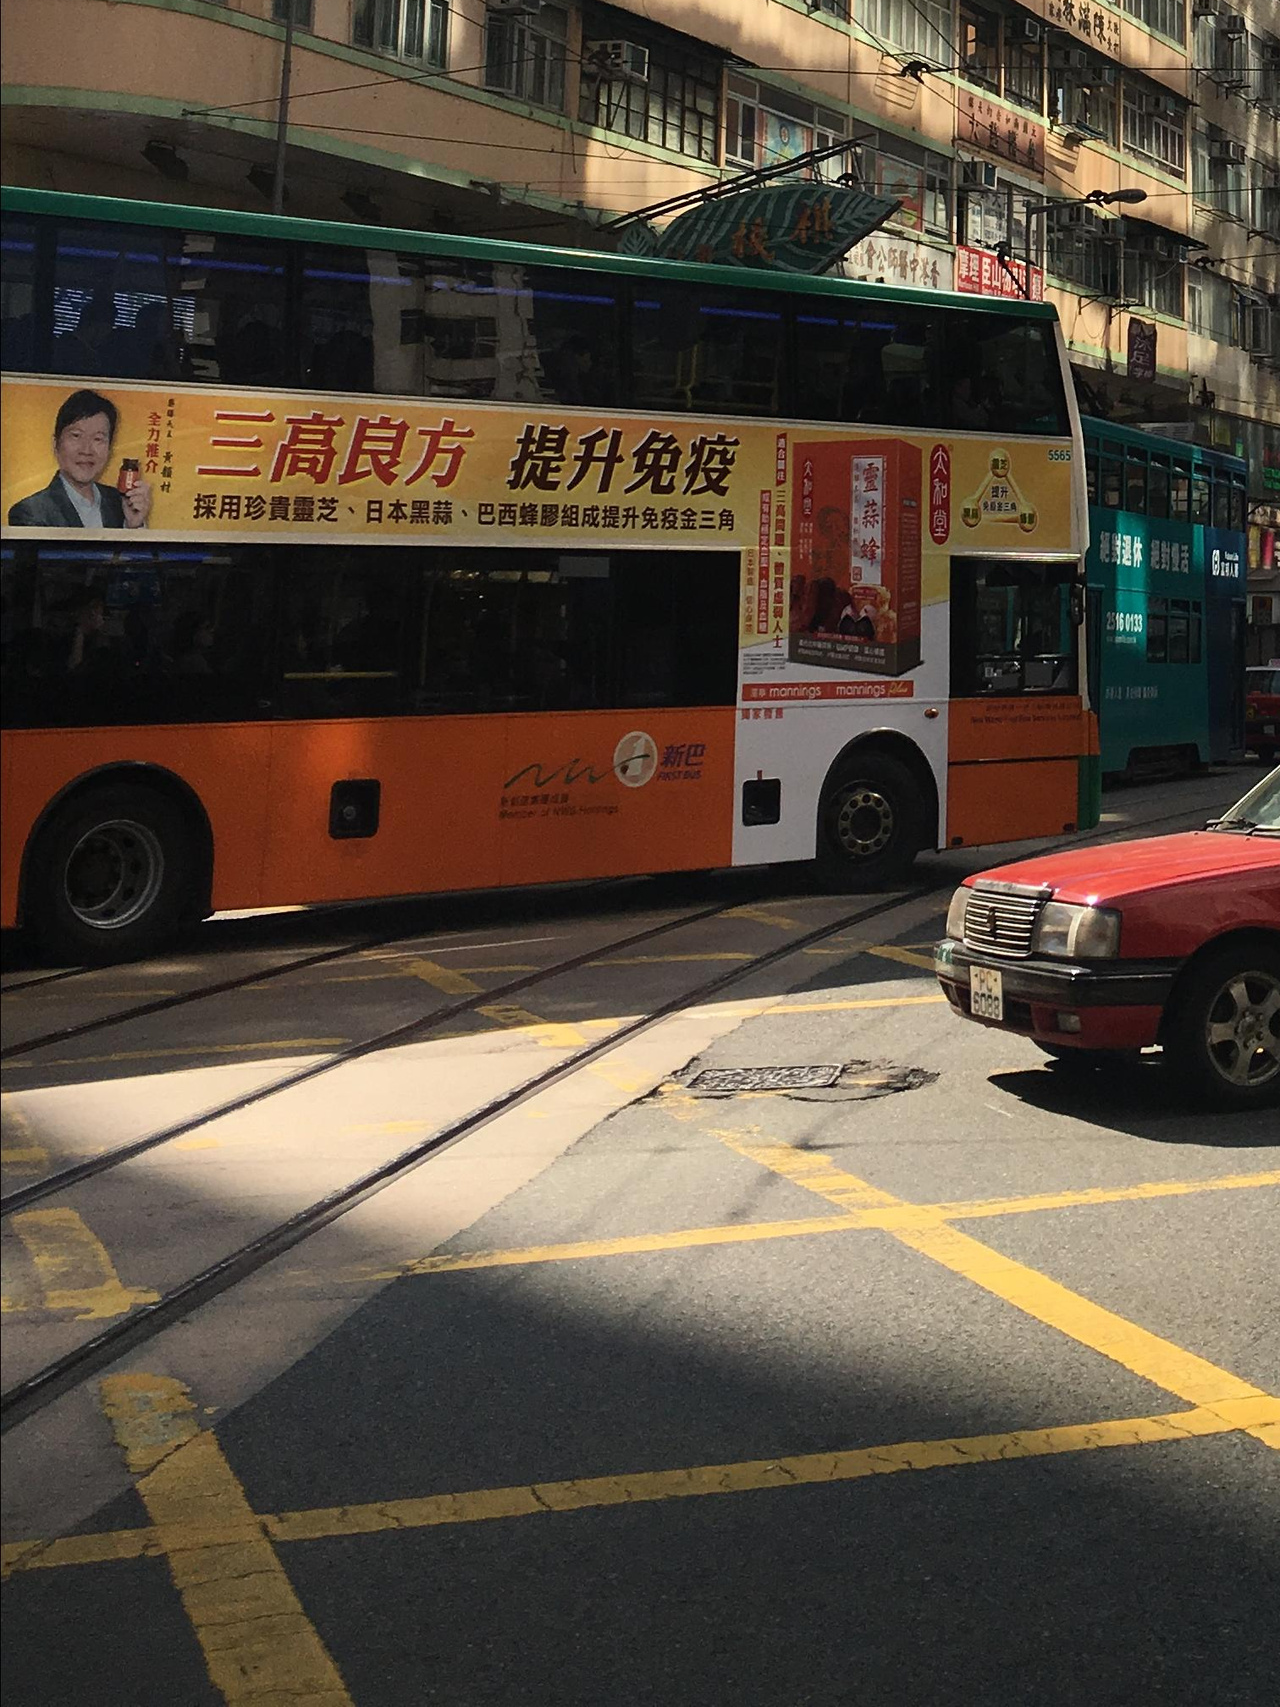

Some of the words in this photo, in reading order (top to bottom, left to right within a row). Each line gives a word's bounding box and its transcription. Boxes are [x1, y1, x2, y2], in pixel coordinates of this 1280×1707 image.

[144, 410, 162, 474] 全力推介
[196, 410, 476, 488] 三高良方
[506, 423, 742, 498] 提升免疫
[1048, 449, 1071, 462] 5565
[991, 485, 1009, 499] 提升
[1106, 611, 1125, 633] 2516
[1125, 613, 1143, 633] 0133
[769, 685, 822, 700] mannings
[836, 682, 886, 698] mannings
[661, 743, 706, 767] 新巴
